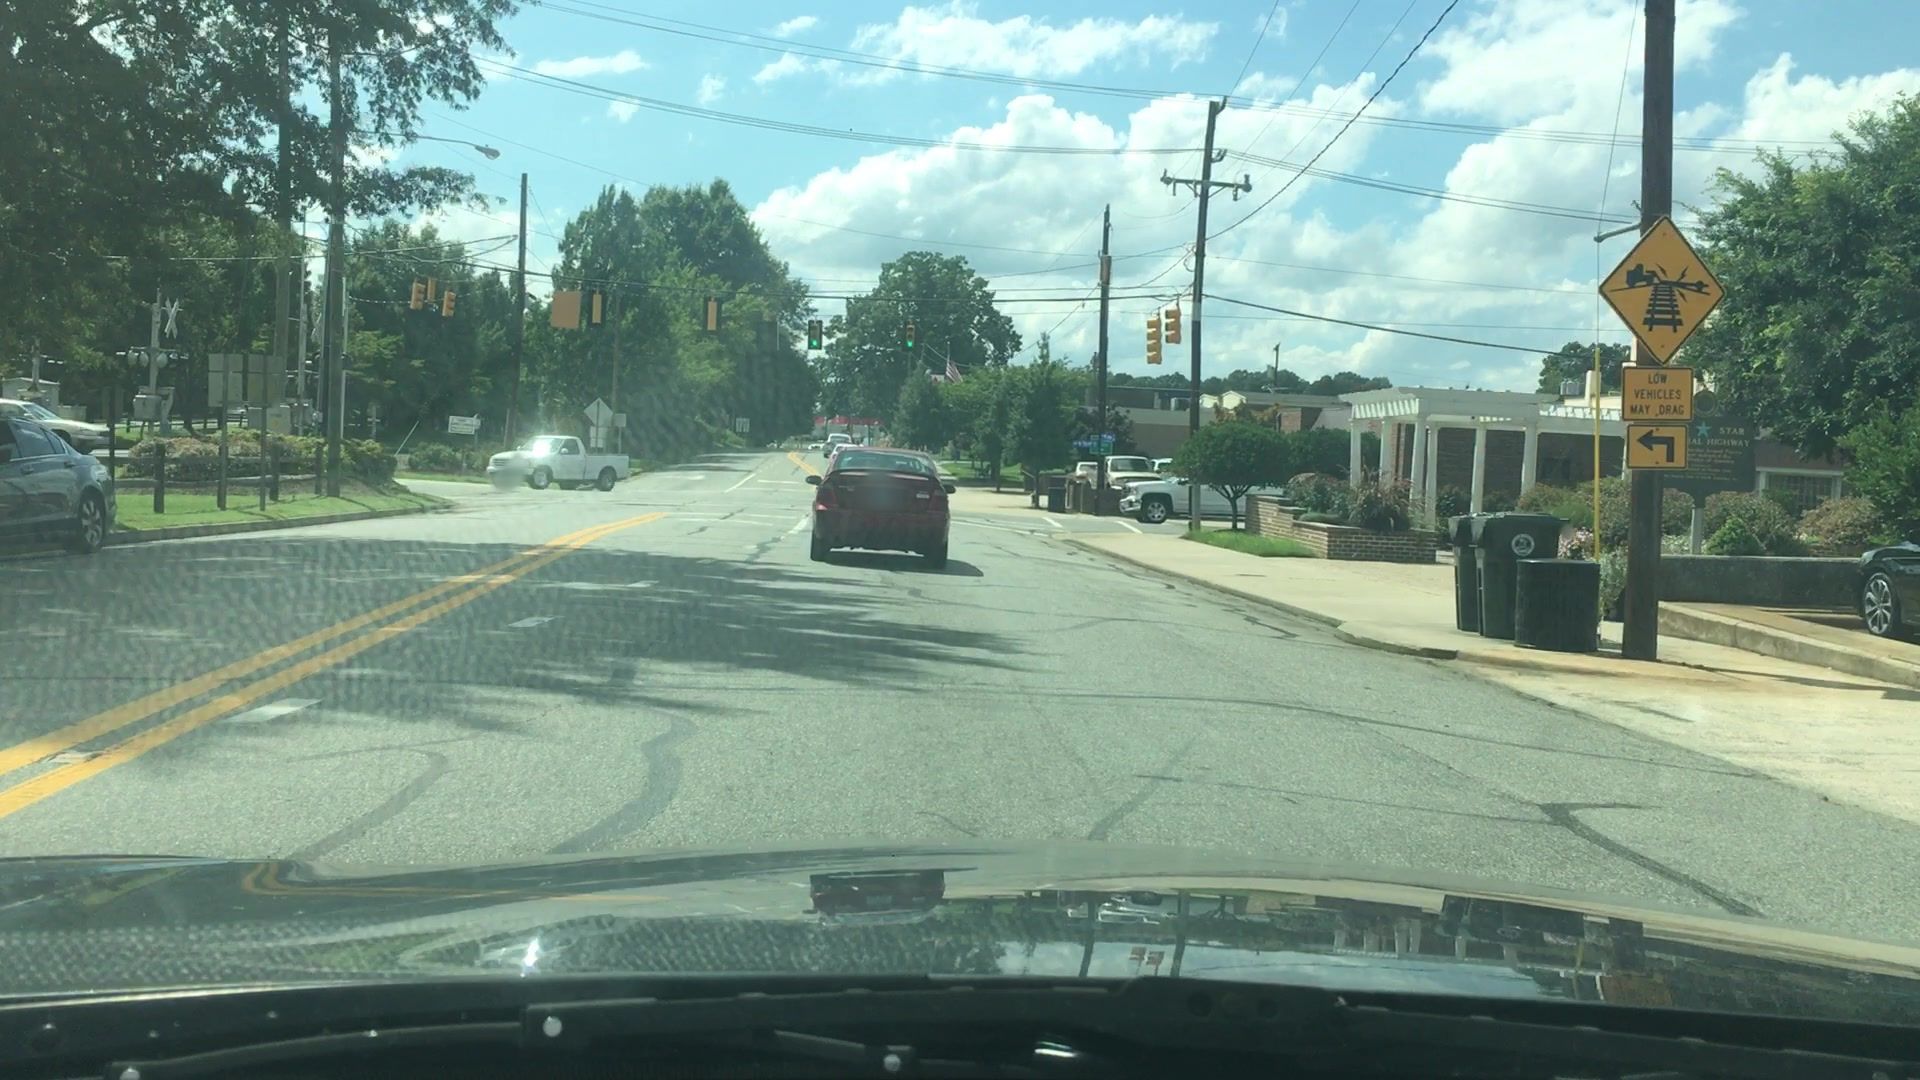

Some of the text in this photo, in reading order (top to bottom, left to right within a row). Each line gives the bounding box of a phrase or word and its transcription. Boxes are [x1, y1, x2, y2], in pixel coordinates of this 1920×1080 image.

[1648, 373, 1667, 384] LOW
[1634, 388, 1681, 400] VEHICLES
[1630, 404, 1684, 416] MAY DRAG
[1719, 427, 1745, 436] STAR
[1706, 438, 1751, 447] HIGHWAY
